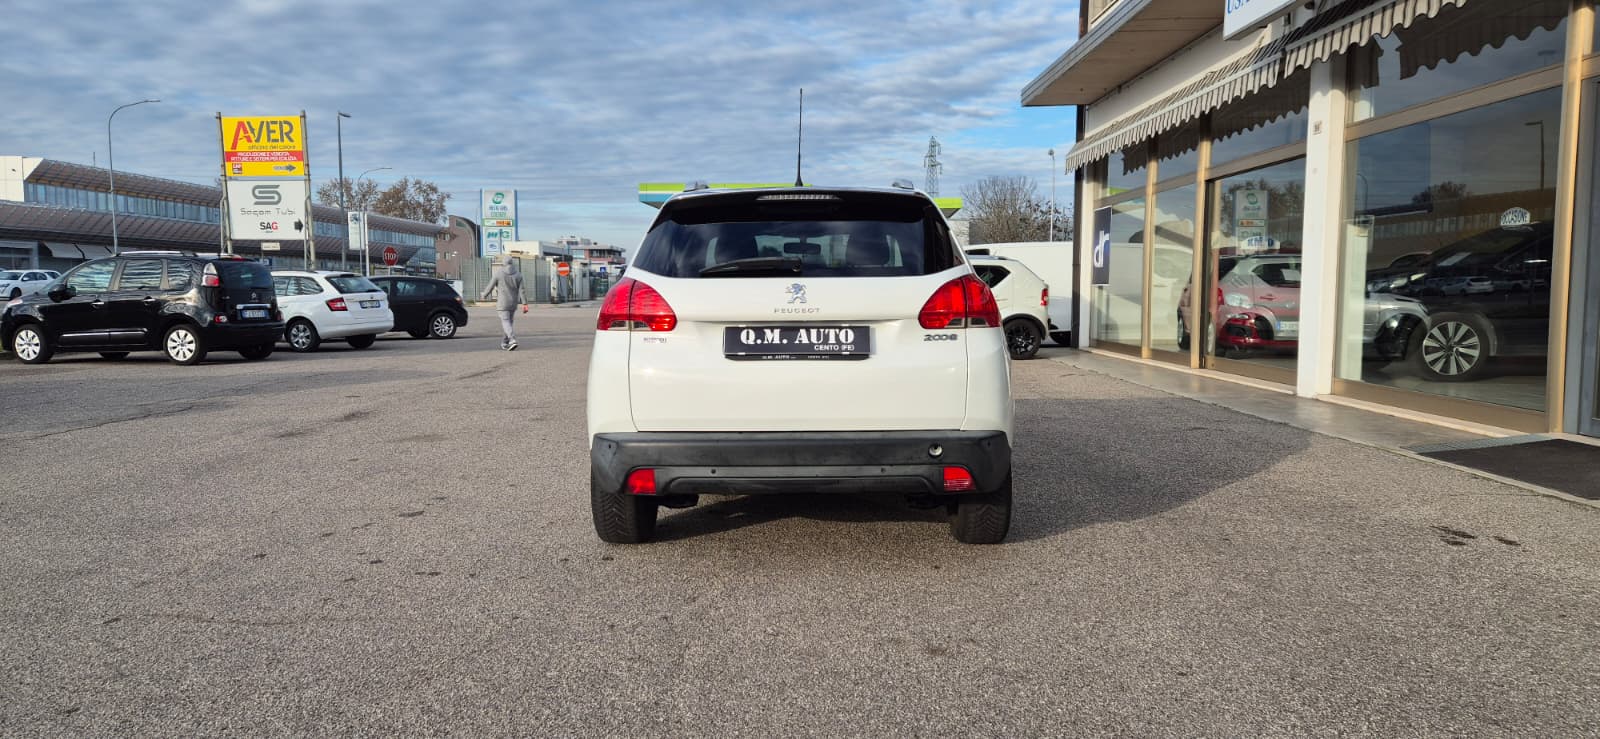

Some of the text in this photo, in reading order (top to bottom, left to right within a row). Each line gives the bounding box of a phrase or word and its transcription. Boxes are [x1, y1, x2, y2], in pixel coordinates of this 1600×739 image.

[231, 120, 295, 150] AVER
[260, 221, 279, 230] SAG
[1094, 230, 1110, 268] dr
[384, 252, 397, 261] STOP
[740, 328, 855, 345] Q.M. AUTO
[923, 334, 958, 342] 2008
